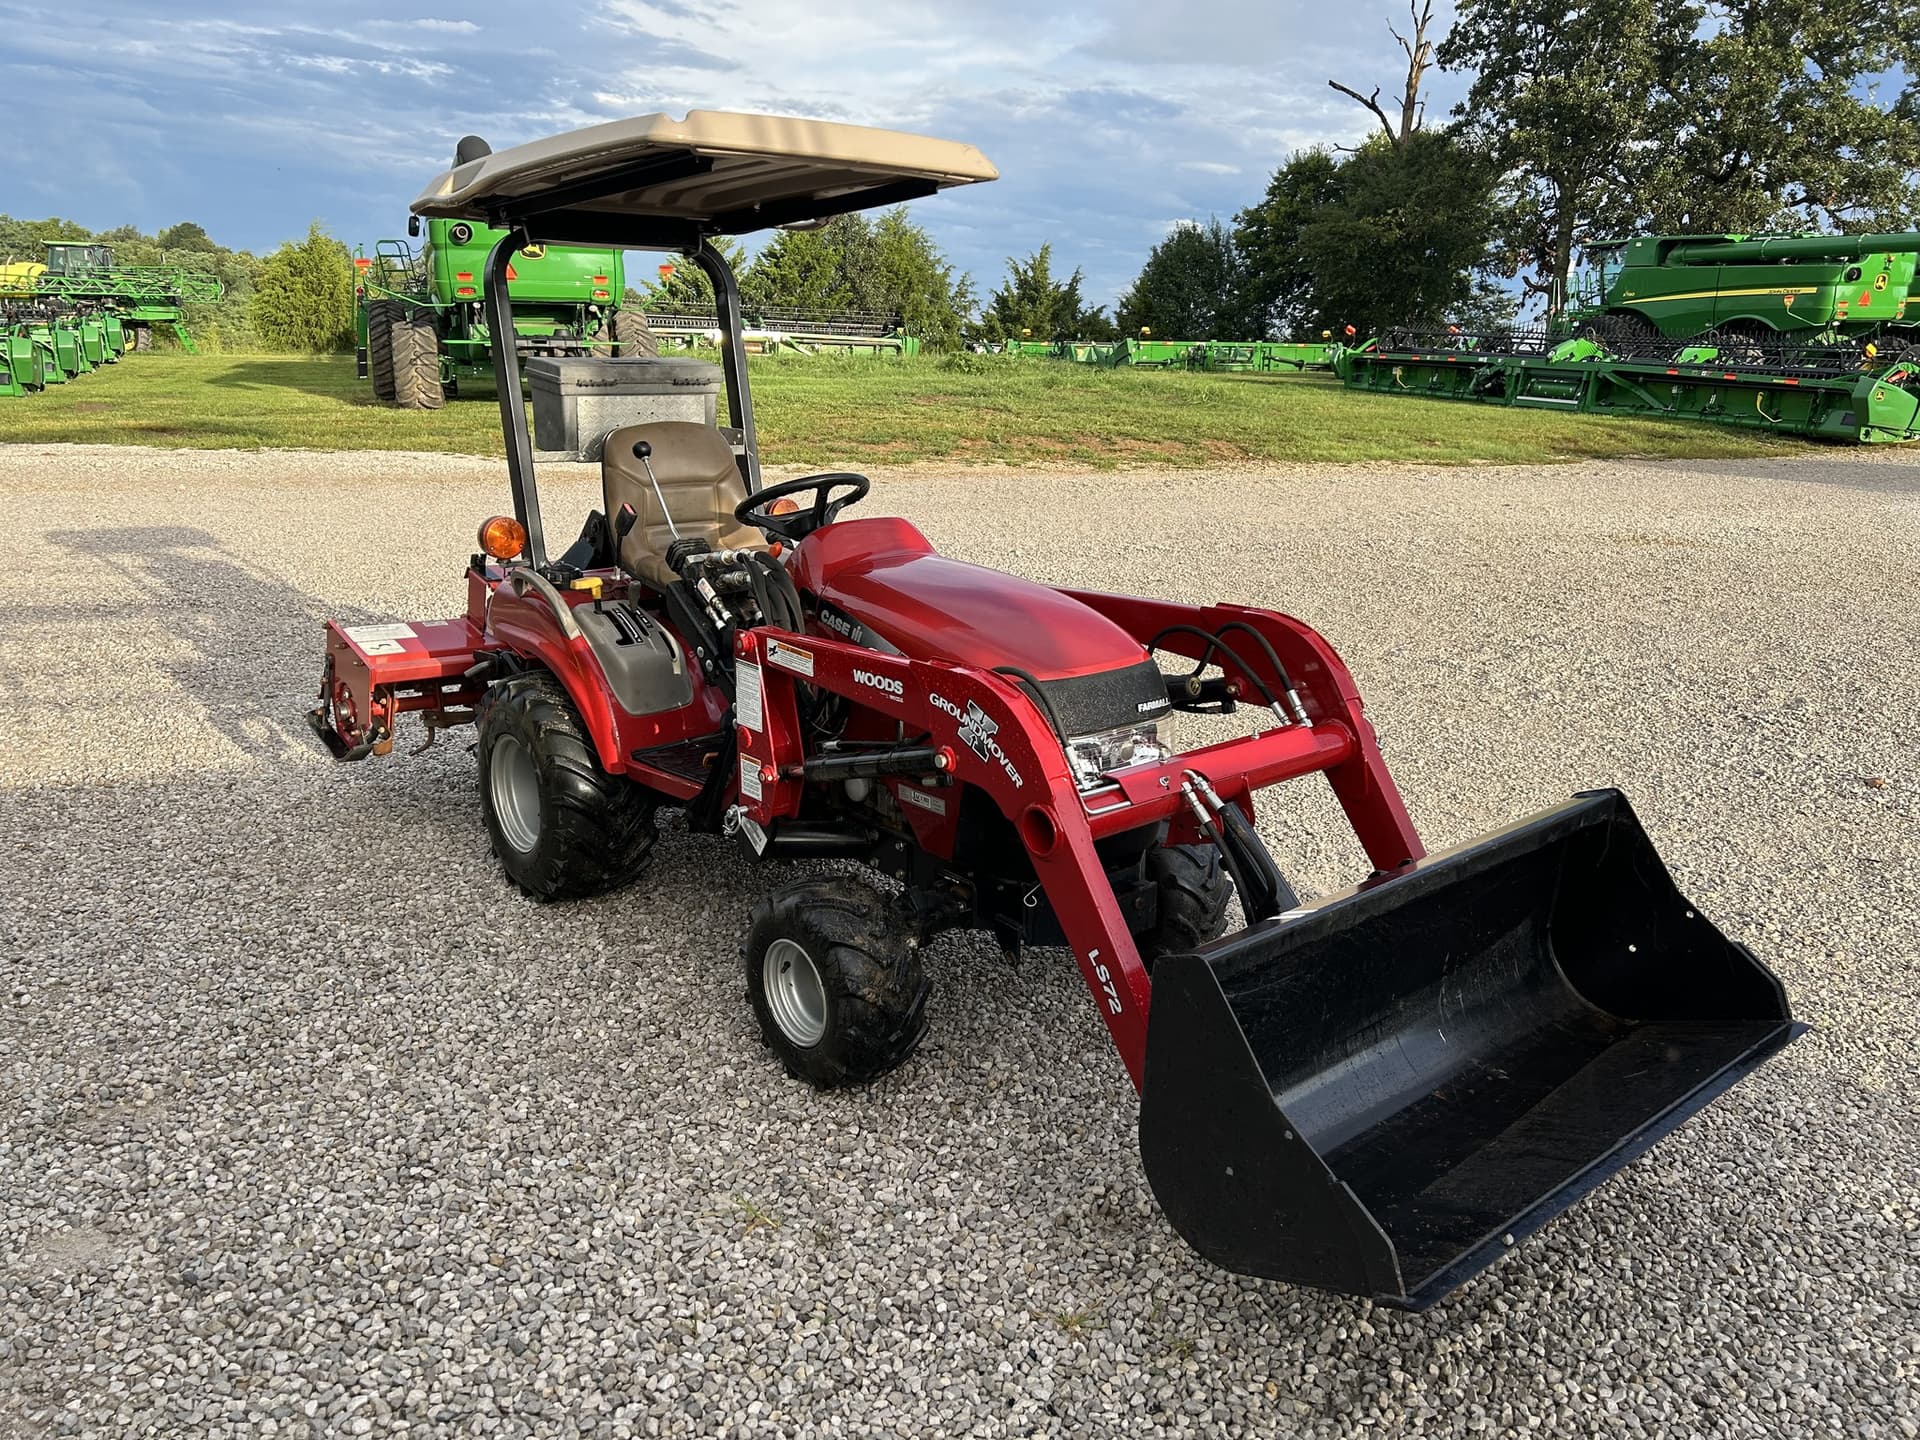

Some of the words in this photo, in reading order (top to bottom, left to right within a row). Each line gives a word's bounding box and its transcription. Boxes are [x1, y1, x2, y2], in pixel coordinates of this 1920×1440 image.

[821, 609, 851, 637] CASE
[853, 669, 904, 695] WOODS
[1137, 697, 1171, 713] FARMALL
[929, 693, 1023, 789] GROUNDMOVER
[1088, 948, 1122, 1015] LS72
